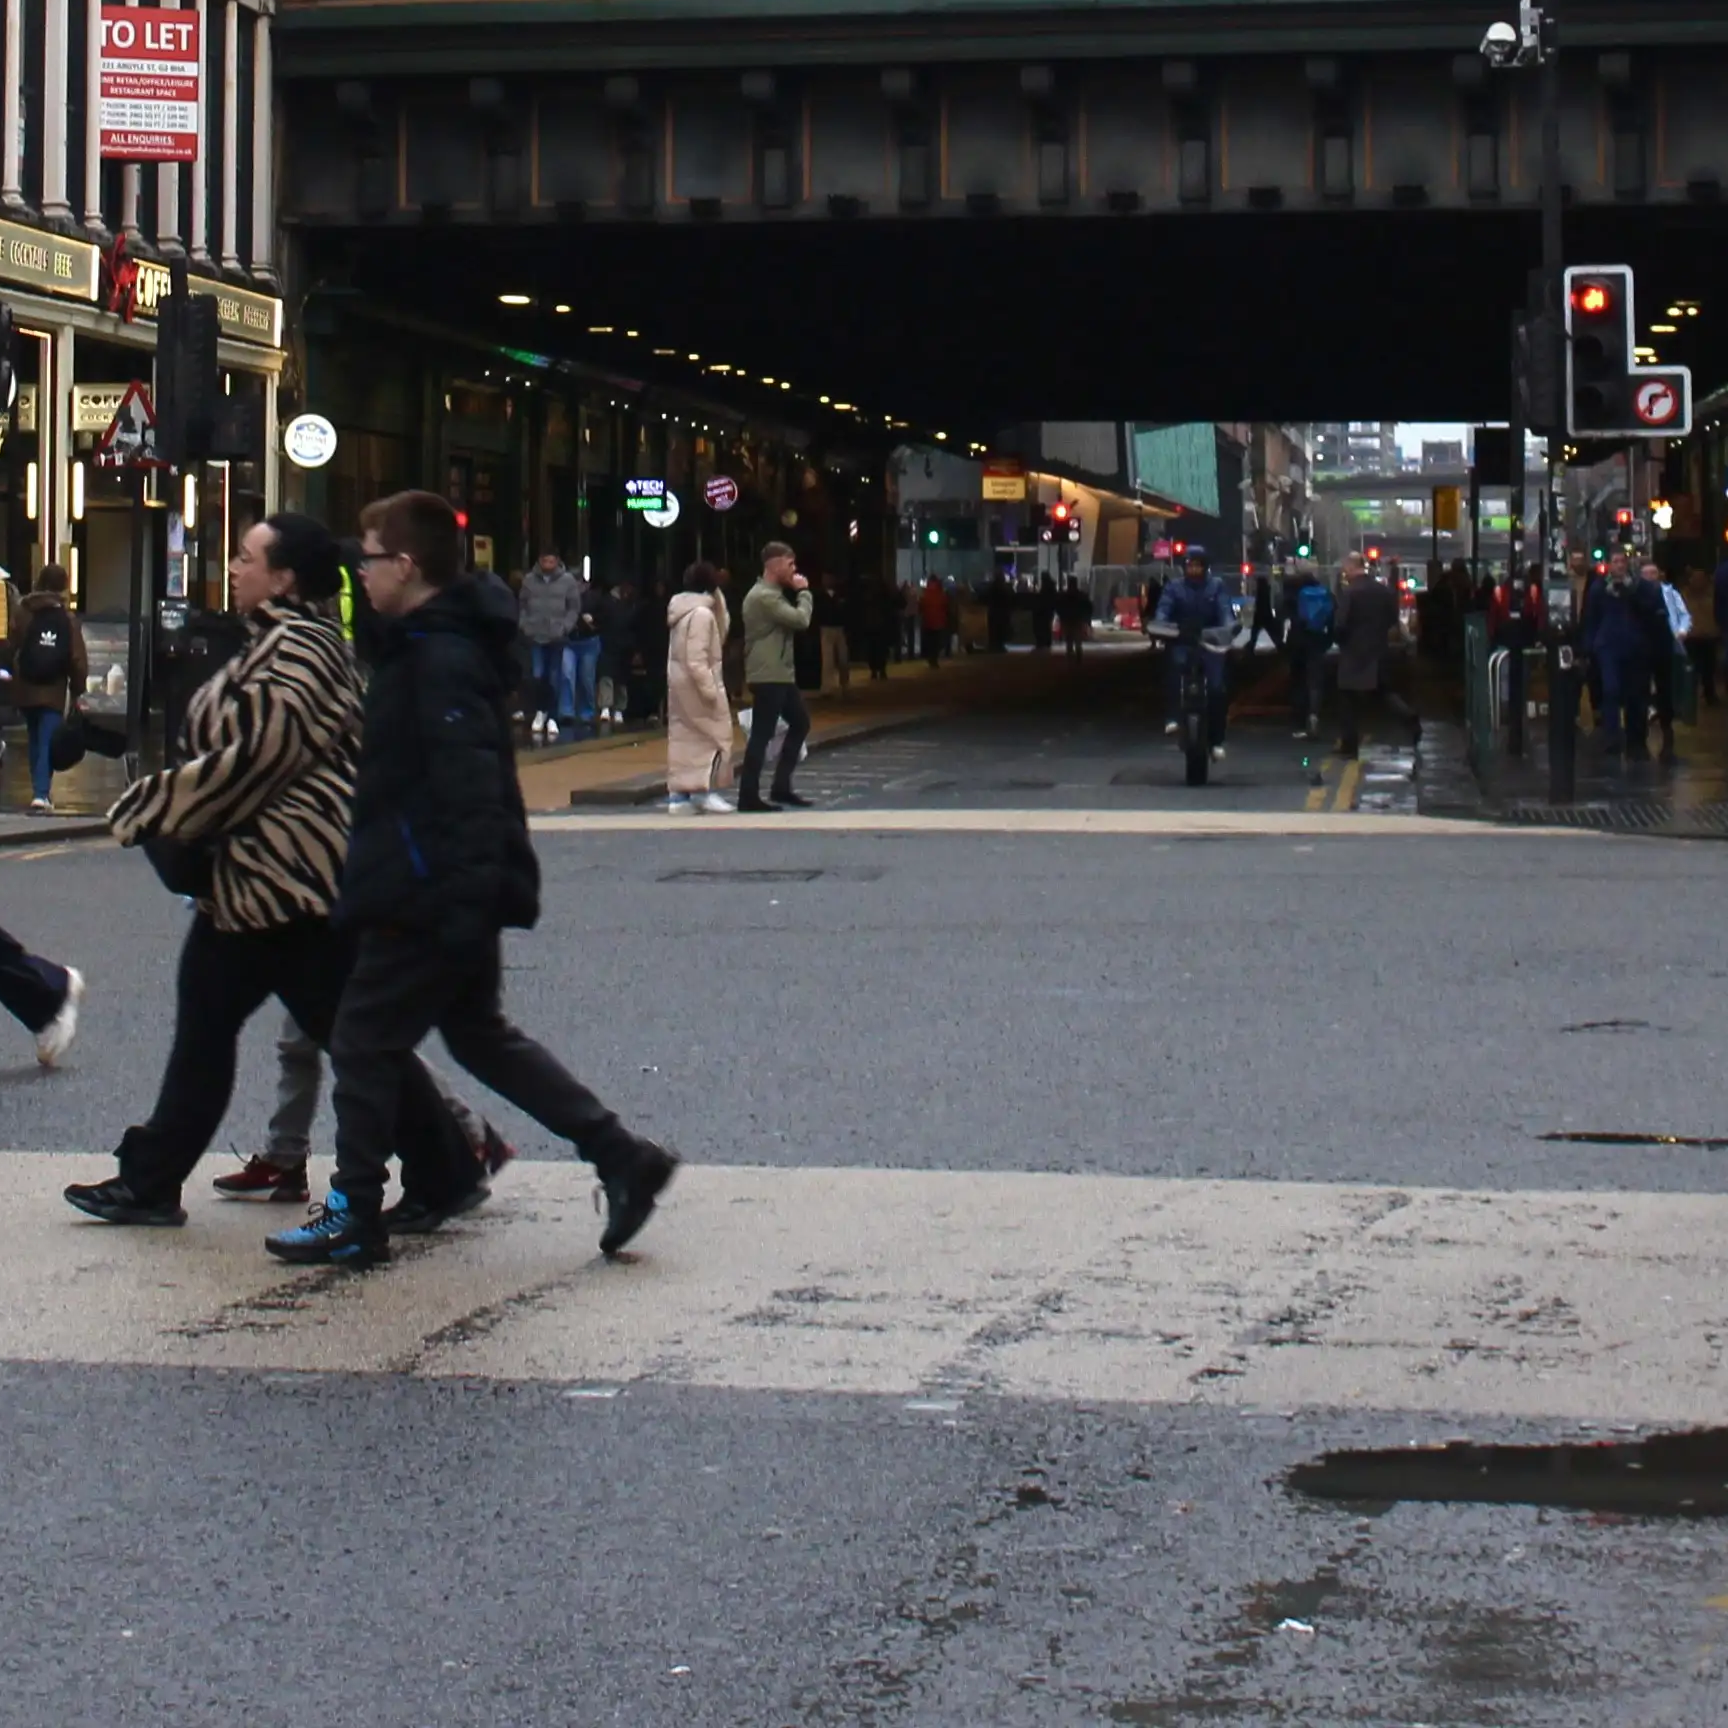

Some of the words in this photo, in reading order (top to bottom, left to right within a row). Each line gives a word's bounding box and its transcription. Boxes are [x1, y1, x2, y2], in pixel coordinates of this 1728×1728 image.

[101, 20, 136, 49] TO
[145, 22, 194, 52] LET
[110, 87, 155, 96] RESTAURANT
[110, 133, 125, 144] ALL
[10, 239, 49, 272] COCKTAILS
[54, 251, 73, 279] BEER
[136, 265, 172, 308] COFF
[79, 394, 123, 409] COFF
[636, 479, 664, 492] TECH
